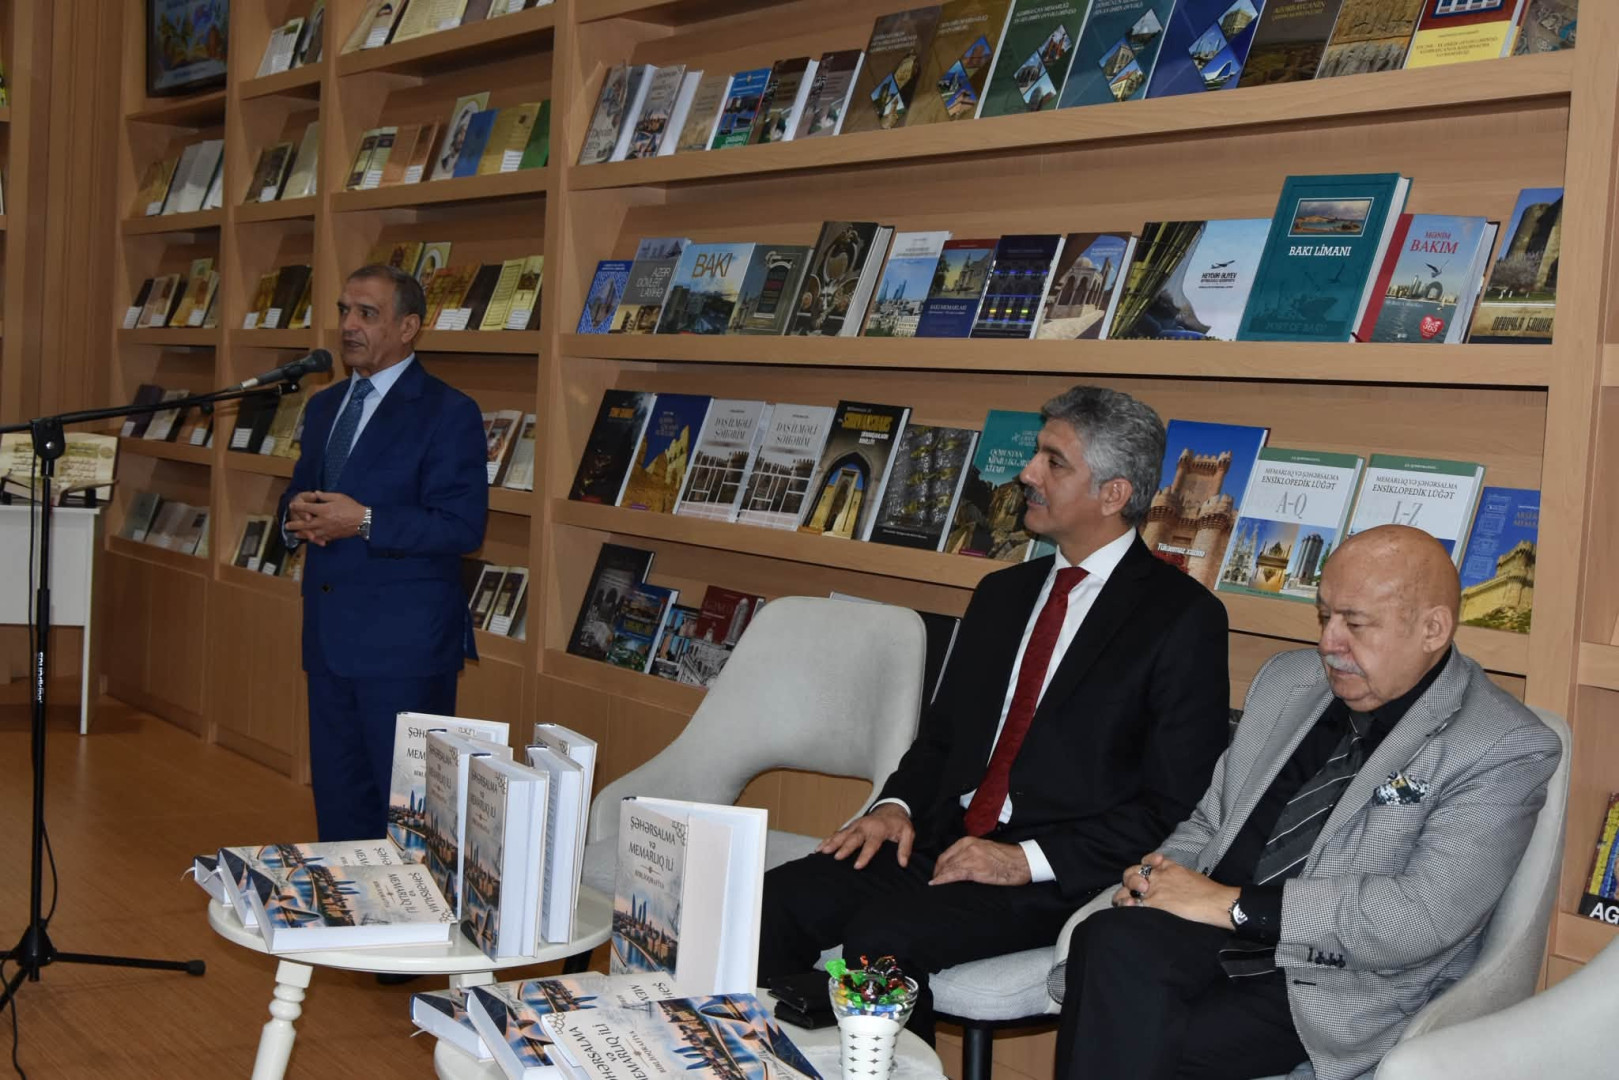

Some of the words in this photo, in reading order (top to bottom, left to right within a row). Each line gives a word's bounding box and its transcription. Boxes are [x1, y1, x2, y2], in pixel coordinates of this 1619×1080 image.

[1288, 246, 1313, 256] BAKI
[1314, 244, 1352, 256] LİMANI
[1410, 239, 1459, 254] BAKIM
[692, 252, 733, 278] BAKI
[1261, 475, 1311, 488] ENSİKLOPEDİK
[1312, 479, 1336, 490] LÜĞƏT
[1265, 468, 1294, 478] MEMARLIQ
[1302, 471, 1339, 481] ŞƏHƏRSALMA
[1376, 475, 1408, 486] MEMARLIQ
[1417, 479, 1458, 490] ŞƏHƏRSALMA
[1372, 484, 1427, 497] ENSİKLOPEDİK
[1428, 488, 1455, 500] LÜĞƏT
[1275, 491, 1307, 519] A-Q
[630, 816, 676, 846] ŞƏHƏRSALMA
[629, 841, 665, 872] MEMARLIQ
[387, 873, 413, 906] MEMARLIQ
[408, 872, 441, 914] ŞƏHƏRSALMA
[592, 1023, 613, 1036] İLİ
[569, 1026, 618, 1080] HƏRSALMA
[606, 1052, 617, 1063] və
